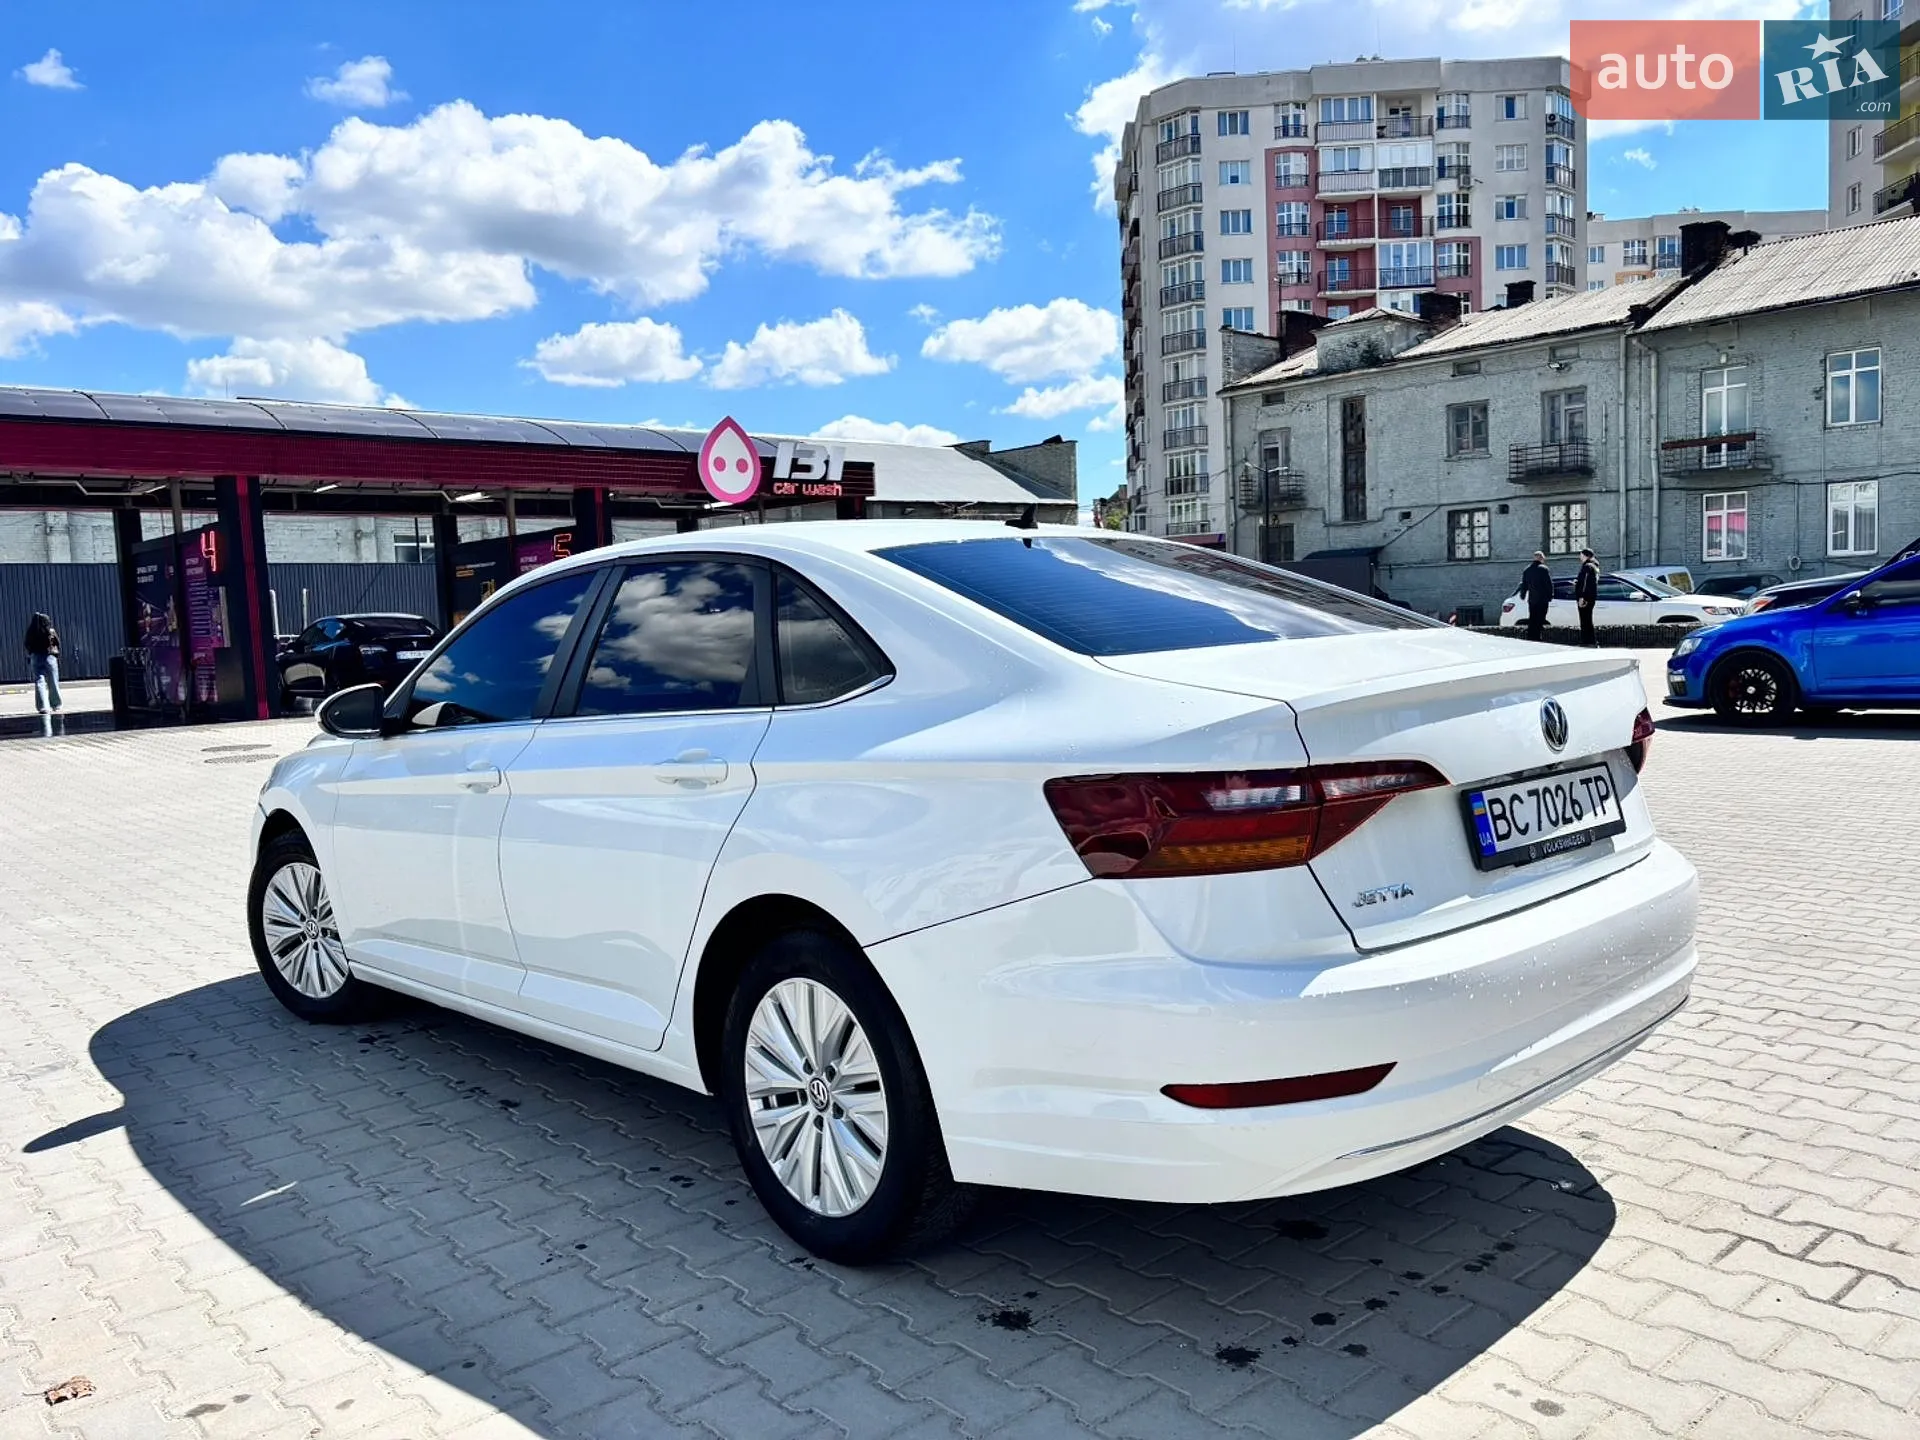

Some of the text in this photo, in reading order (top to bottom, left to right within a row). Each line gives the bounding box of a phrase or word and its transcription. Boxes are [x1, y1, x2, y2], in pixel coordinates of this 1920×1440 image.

[772, 482, 843, 497] car wash
[200, 530, 217, 573] 4
[553, 533, 572, 559] 5
[1526, 781, 1584, 832] 7026
[1479, 831, 1494, 846] UA
[1541, 833, 1586, 855] VOLKSWAGEN
[1352, 882, 1414, 907] JETTA
